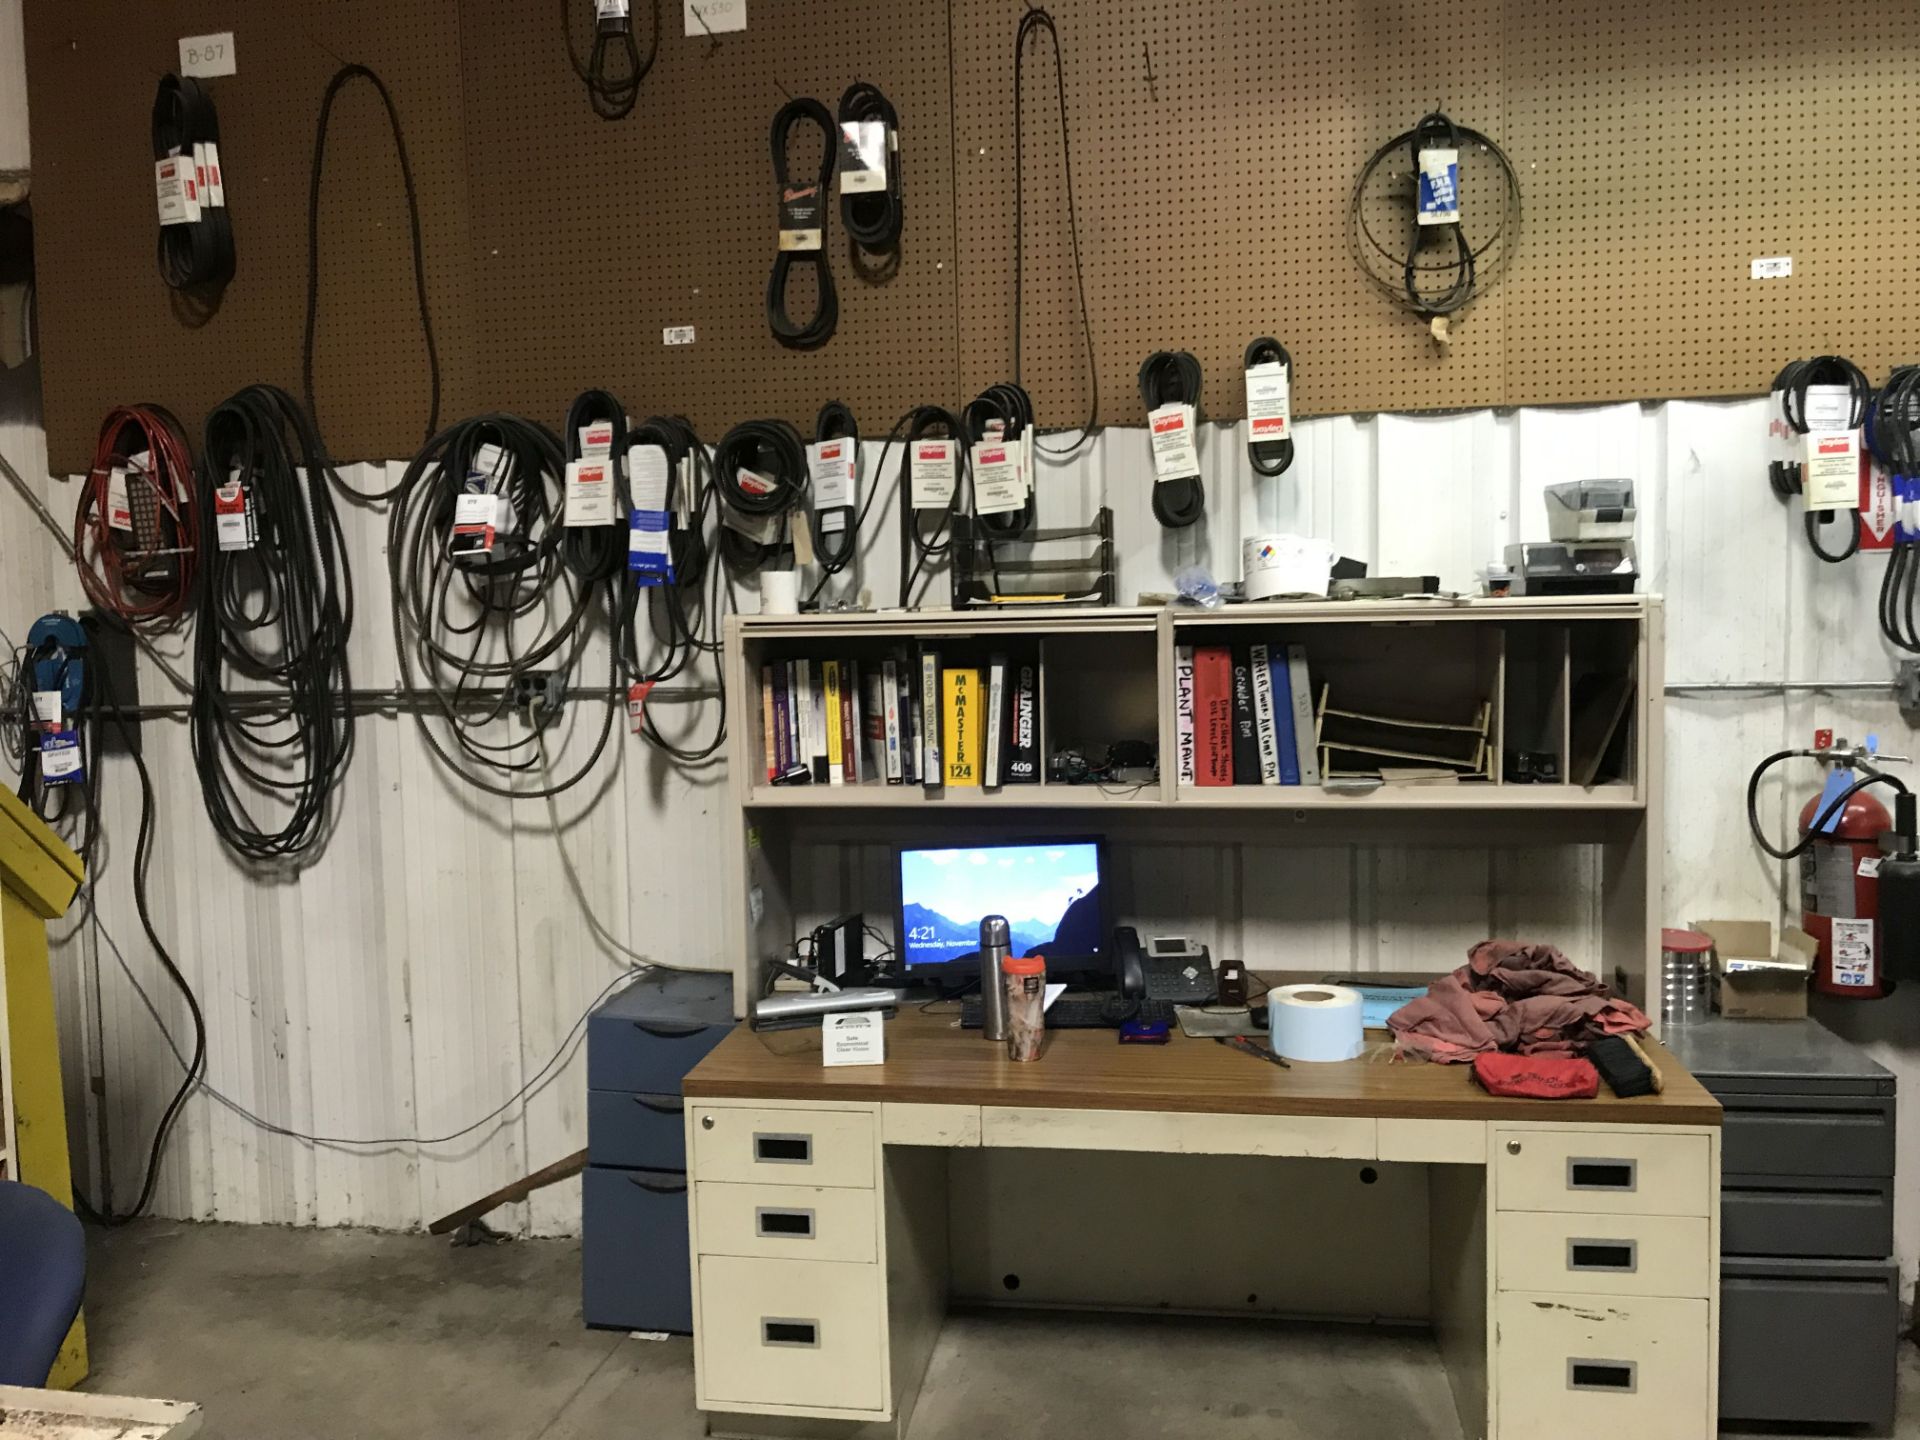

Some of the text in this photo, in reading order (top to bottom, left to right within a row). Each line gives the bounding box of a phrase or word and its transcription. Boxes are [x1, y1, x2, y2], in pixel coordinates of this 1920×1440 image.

[186, 44, 224, 65] B-87
[1153, 414, 1184, 426] Dayton
[1252, 423, 1284, 435] Dayton
[1817, 435, 1850, 448] Dayton
[919, 445, 946, 456] Dayton
[979, 448, 1006, 460] Dayton
[578, 466, 604, 478] Dayton
[1019, 666, 1032, 748] GRAINGER
[955, 674, 967, 763] McMASTER
[1178, 665, 1193, 781] PLANT MAINT.
[950, 765, 972, 777] 124
[1011, 762, 1032, 773] 409
[908, 926, 935, 940] 4:21
[908, 940, 977, 950] Wednesday, November
